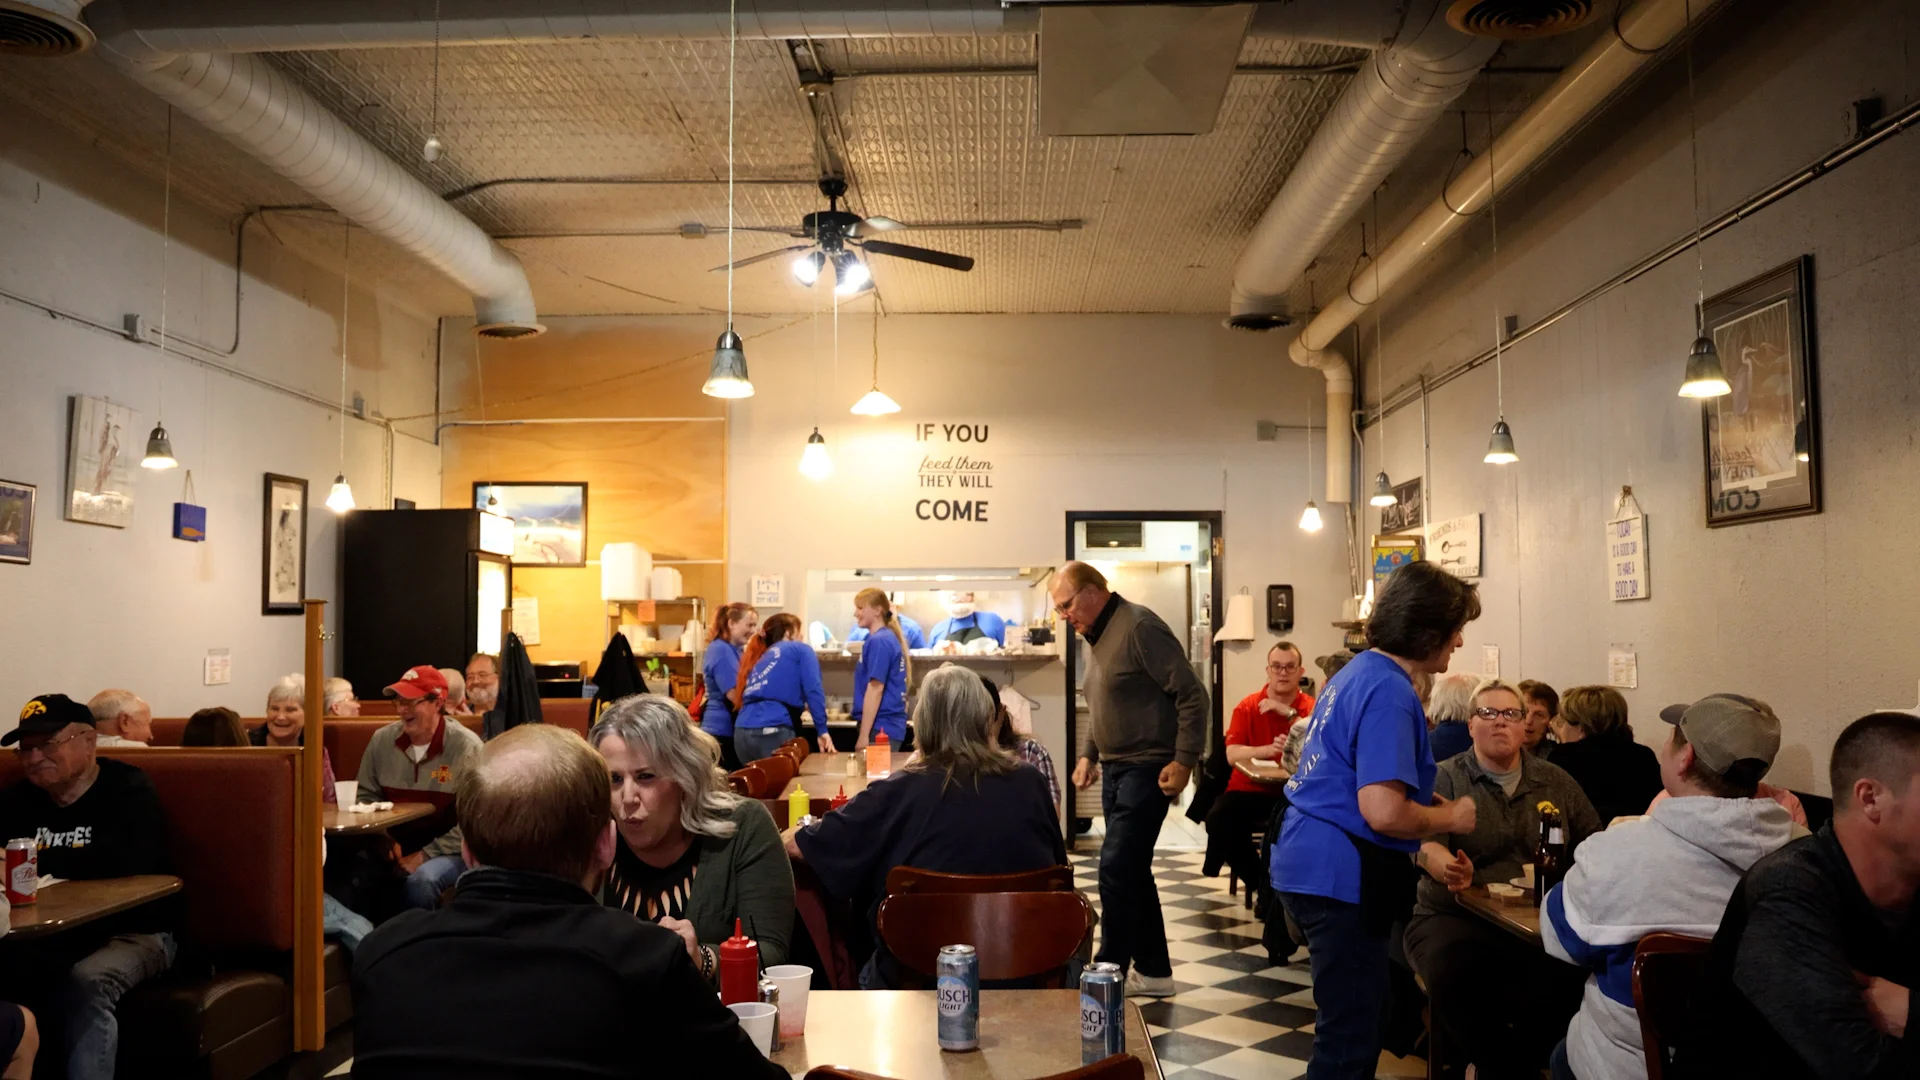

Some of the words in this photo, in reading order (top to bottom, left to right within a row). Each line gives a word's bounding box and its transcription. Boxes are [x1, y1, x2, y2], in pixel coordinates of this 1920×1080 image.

[916, 423, 935, 441] IF
[943, 424, 988, 443] YOU
[918, 455, 953, 473] feed
[955, 456, 994, 470] them
[919, 475, 954, 487] THEY
[959, 475, 993, 488] WILL
[915, 499, 988, 522] COME
[1081, 1009, 1107, 1026] SCH
[1082, 1023, 1097, 1032] GHT
